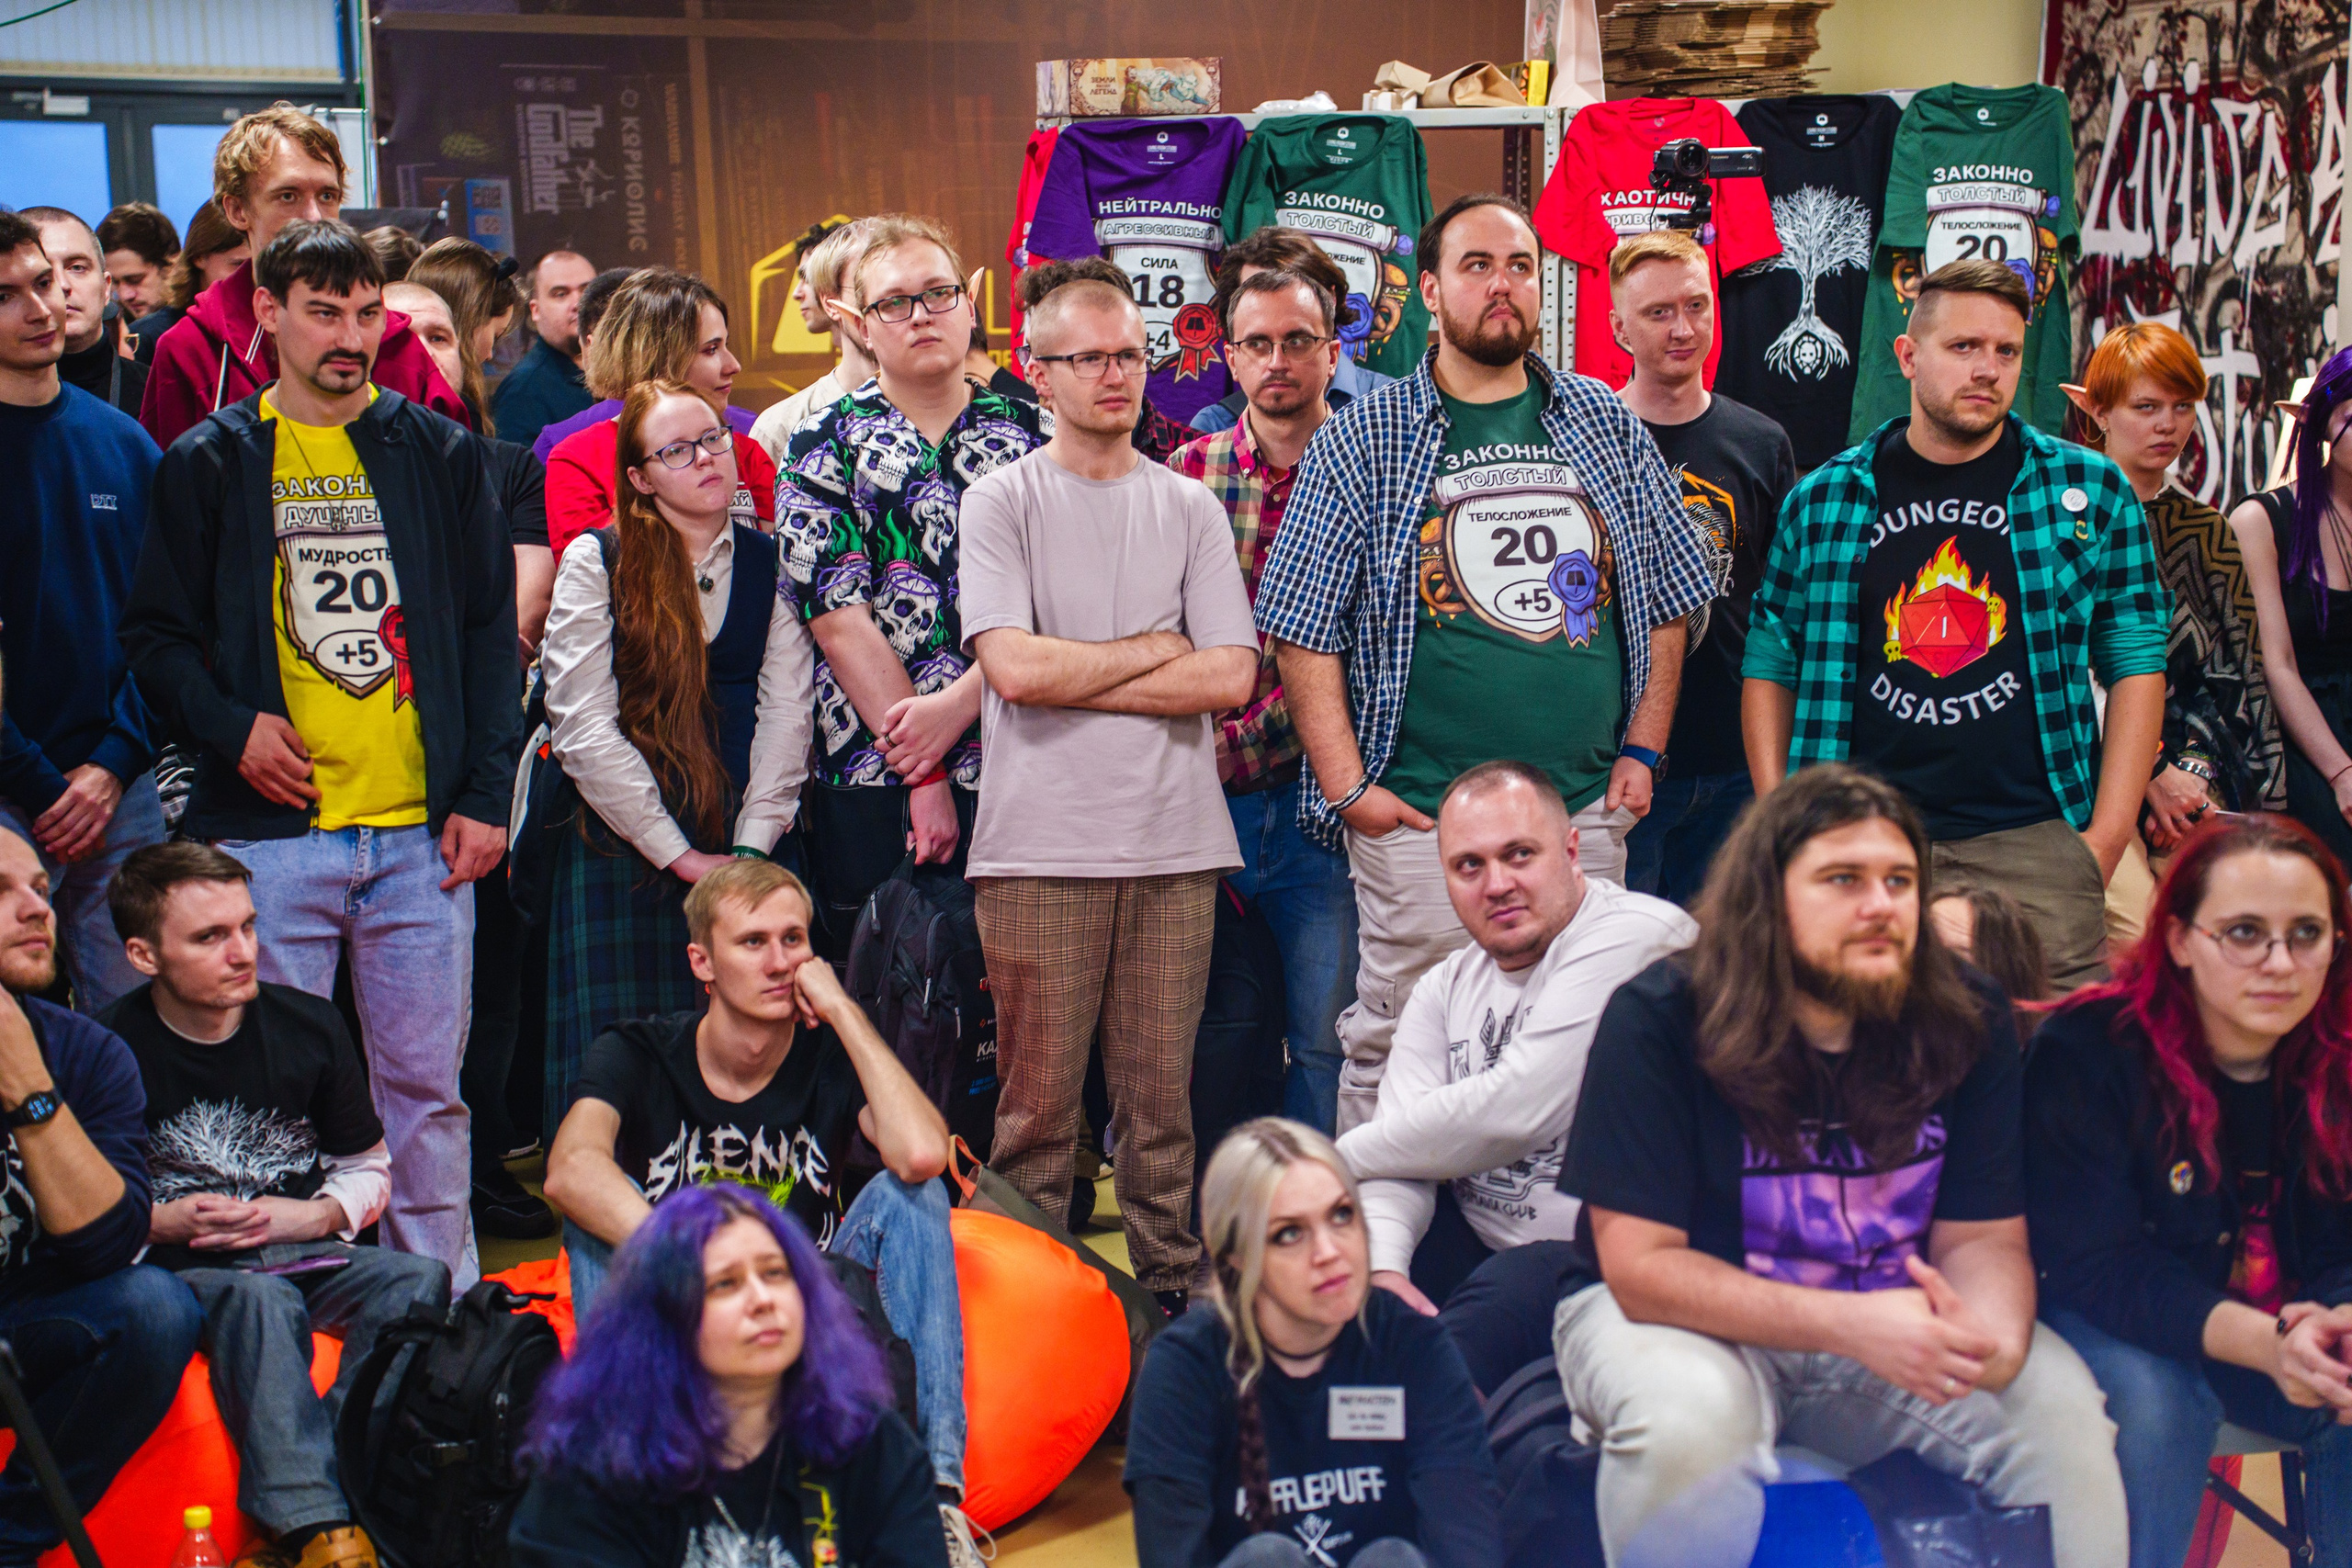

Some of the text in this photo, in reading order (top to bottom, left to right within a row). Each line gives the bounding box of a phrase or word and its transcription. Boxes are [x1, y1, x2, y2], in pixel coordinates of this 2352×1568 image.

[568, 104, 604, 149] The
[526, 104, 571, 216] Godfather
[1933, 164, 2033, 184] ЗАКОННО
[1284, 190, 1385, 220] ЗАКОННО
[1600, 189, 1697, 208] ХАОТИЧН
[1938, 186, 2026, 204] ТОЛСТЫЙ
[1098, 197, 1223, 220] НЕЙТРАЛЬНО
[1104, 223, 1215, 241] АГРЕССИВНЫЙ
[1287, 212, 1374, 239] ТОЛСТЫЙ
[1941, 221, 2021, 230] ТЕЛОСЛОЖЕНИЕ
[1327, 253, 1366, 265] ОЖЕНИЕ
[1955, 234, 2007, 263] 20
[1140, 257, 1178, 269] СИЛА
[1132, 273, 1184, 309] 18
[1443, 444, 1567, 470] ЗАКОННО
[272, 474, 374, 499] ЗАКОН
[1454, 466, 1566, 491] ТОЛСТЫЙ
[284, 505, 383, 529] ДУШНЫ
[1467, 506, 1572, 523] ТЕЛОСЛОЖЕНИЕ
[1490, 525, 1558, 567] 20
[312, 569, 389, 614] 20
[1514, 588, 1552, 613] +5
[335, 638, 379, 667] +5
[1871, 671, 2021, 726] DISASTER
